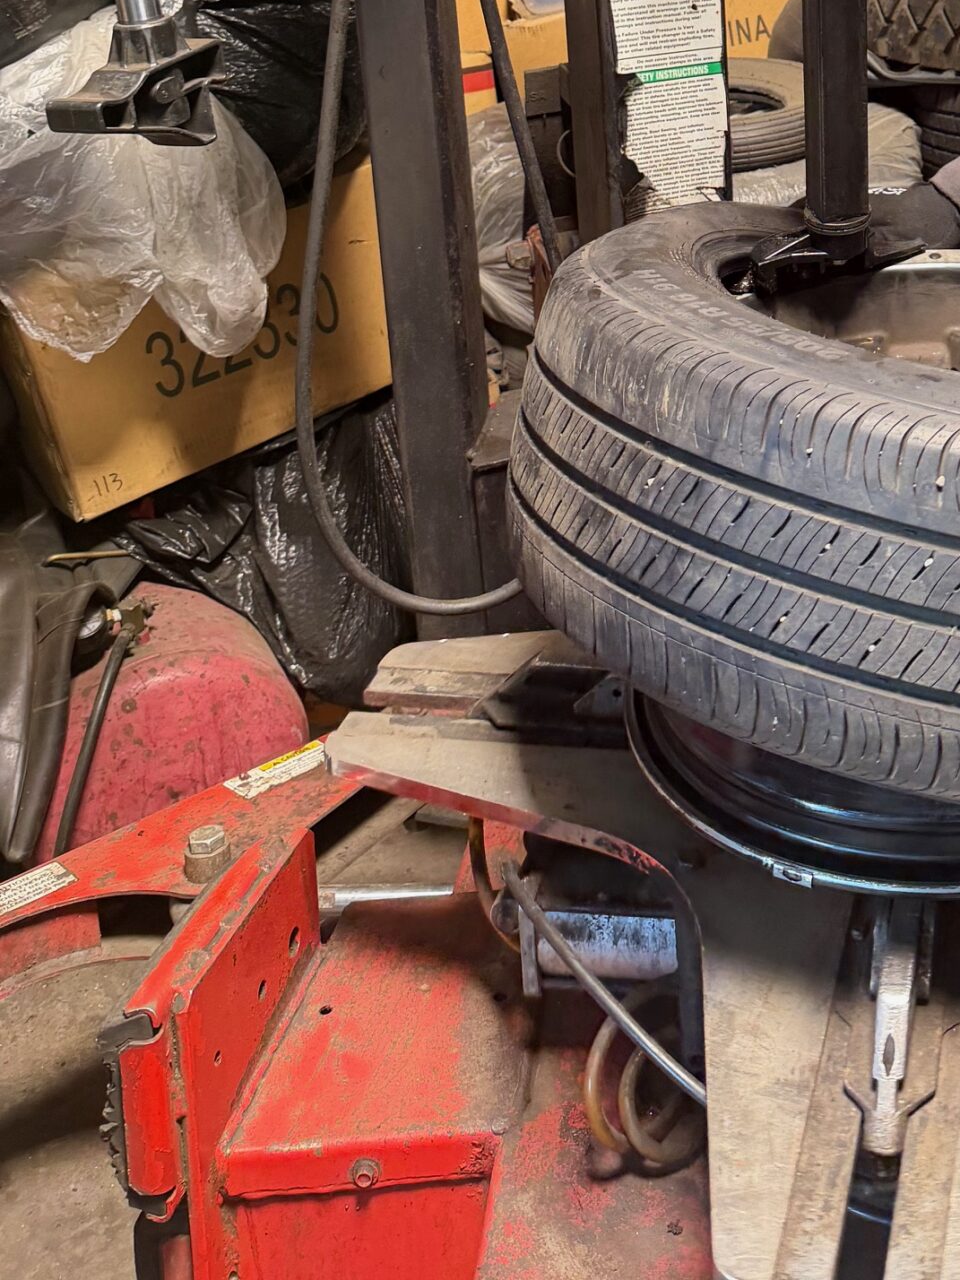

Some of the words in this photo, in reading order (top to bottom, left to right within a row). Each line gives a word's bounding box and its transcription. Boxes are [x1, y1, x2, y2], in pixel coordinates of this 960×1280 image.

[728, 14, 771, 47] INA
[637, 72, 656, 82] ETY
[655, 64, 709, 80] INSTRUCTIONS
